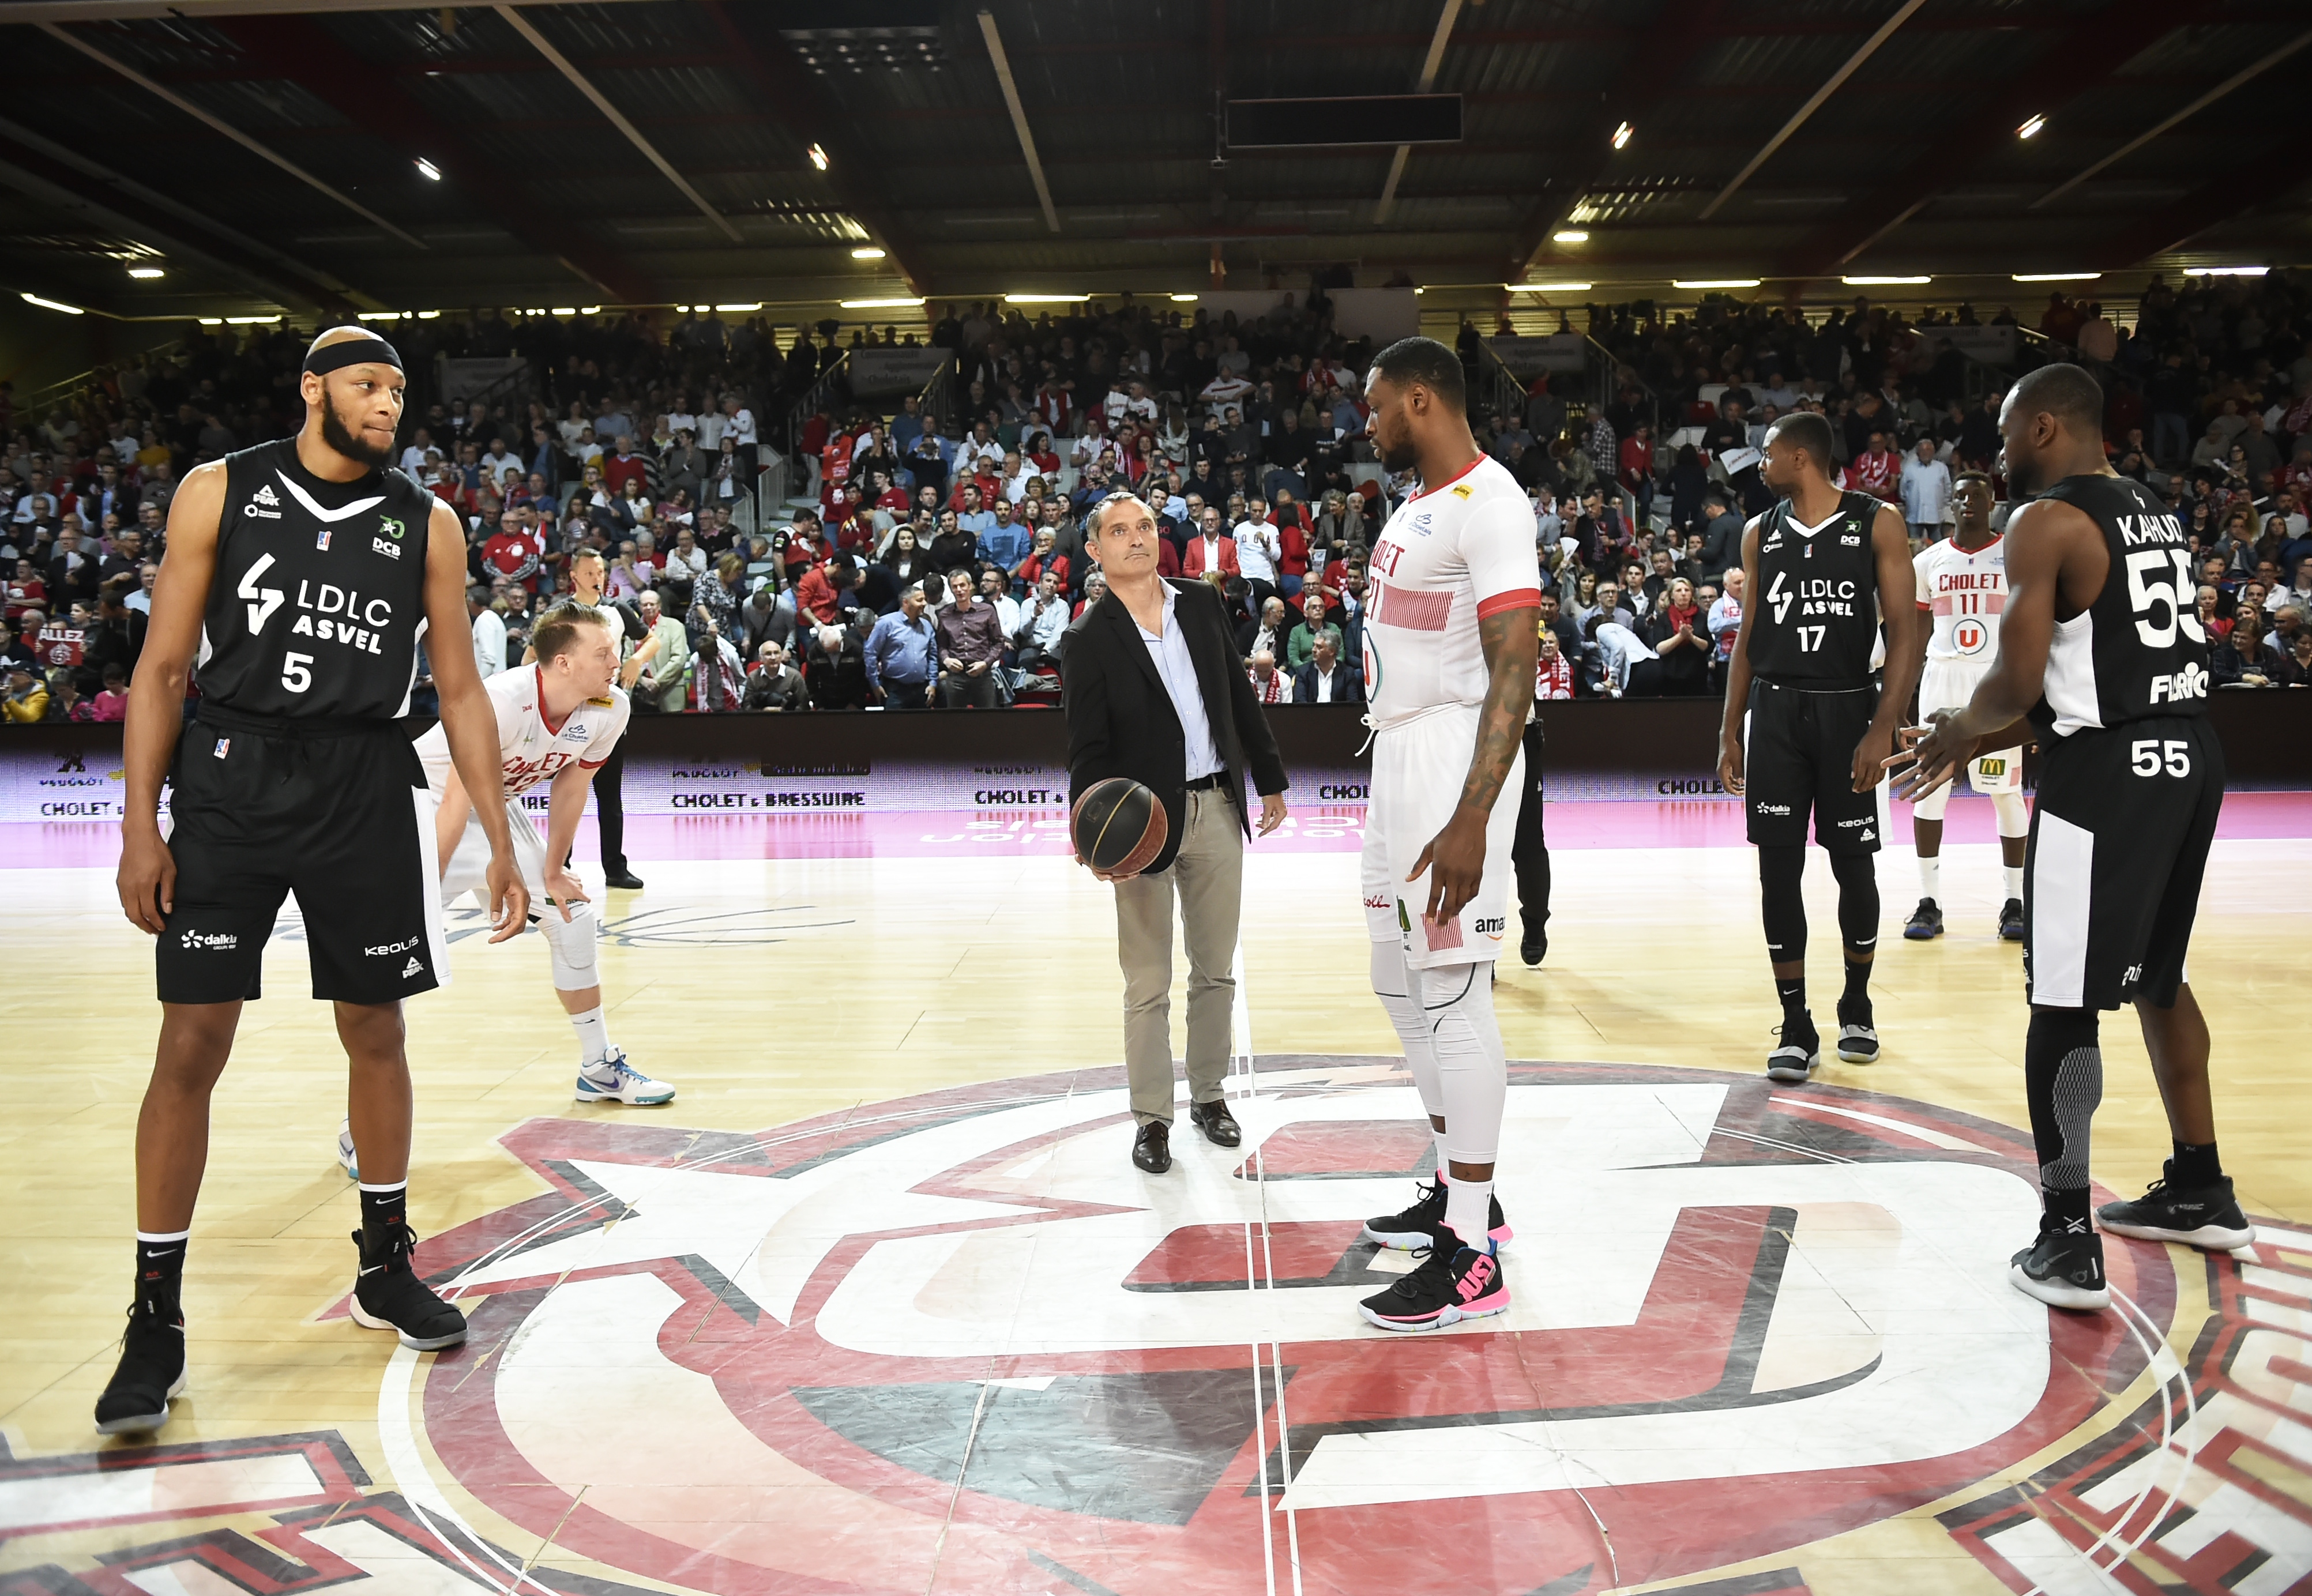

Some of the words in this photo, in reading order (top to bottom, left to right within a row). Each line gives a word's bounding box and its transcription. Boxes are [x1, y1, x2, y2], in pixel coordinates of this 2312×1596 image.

[253, 494, 281, 506] PEAK
[373, 537, 401, 556] DCB
[1840, 535, 1860, 544] DCB
[1800, 579, 1855, 599] LDLC
[1939, 574, 2002, 592] CHOLET
[297, 579, 392, 627] LDLC
[1960, 593, 1979, 615] 11
[2125, 548, 2206, 649] 55
[1802, 601, 1854, 616] ASVEL
[39, 628, 84, 642] ALLEZ
[291, 615, 382, 655] ASVEL
[1796, 625, 1826, 652] 17
[281, 651, 314, 693] 5
[2131, 740, 2190, 778] 55
[1319, 785, 1370, 800] CHOL
[1658, 780, 1725, 794] CHOLE
[672, 793, 747, 808] CHOLET
[766, 792, 866, 806] BRESSUIRE
[975, 790, 1050, 804] CHOLET
[40, 802, 111, 816] CHOLET
[401, 963, 424, 979] PEAK
